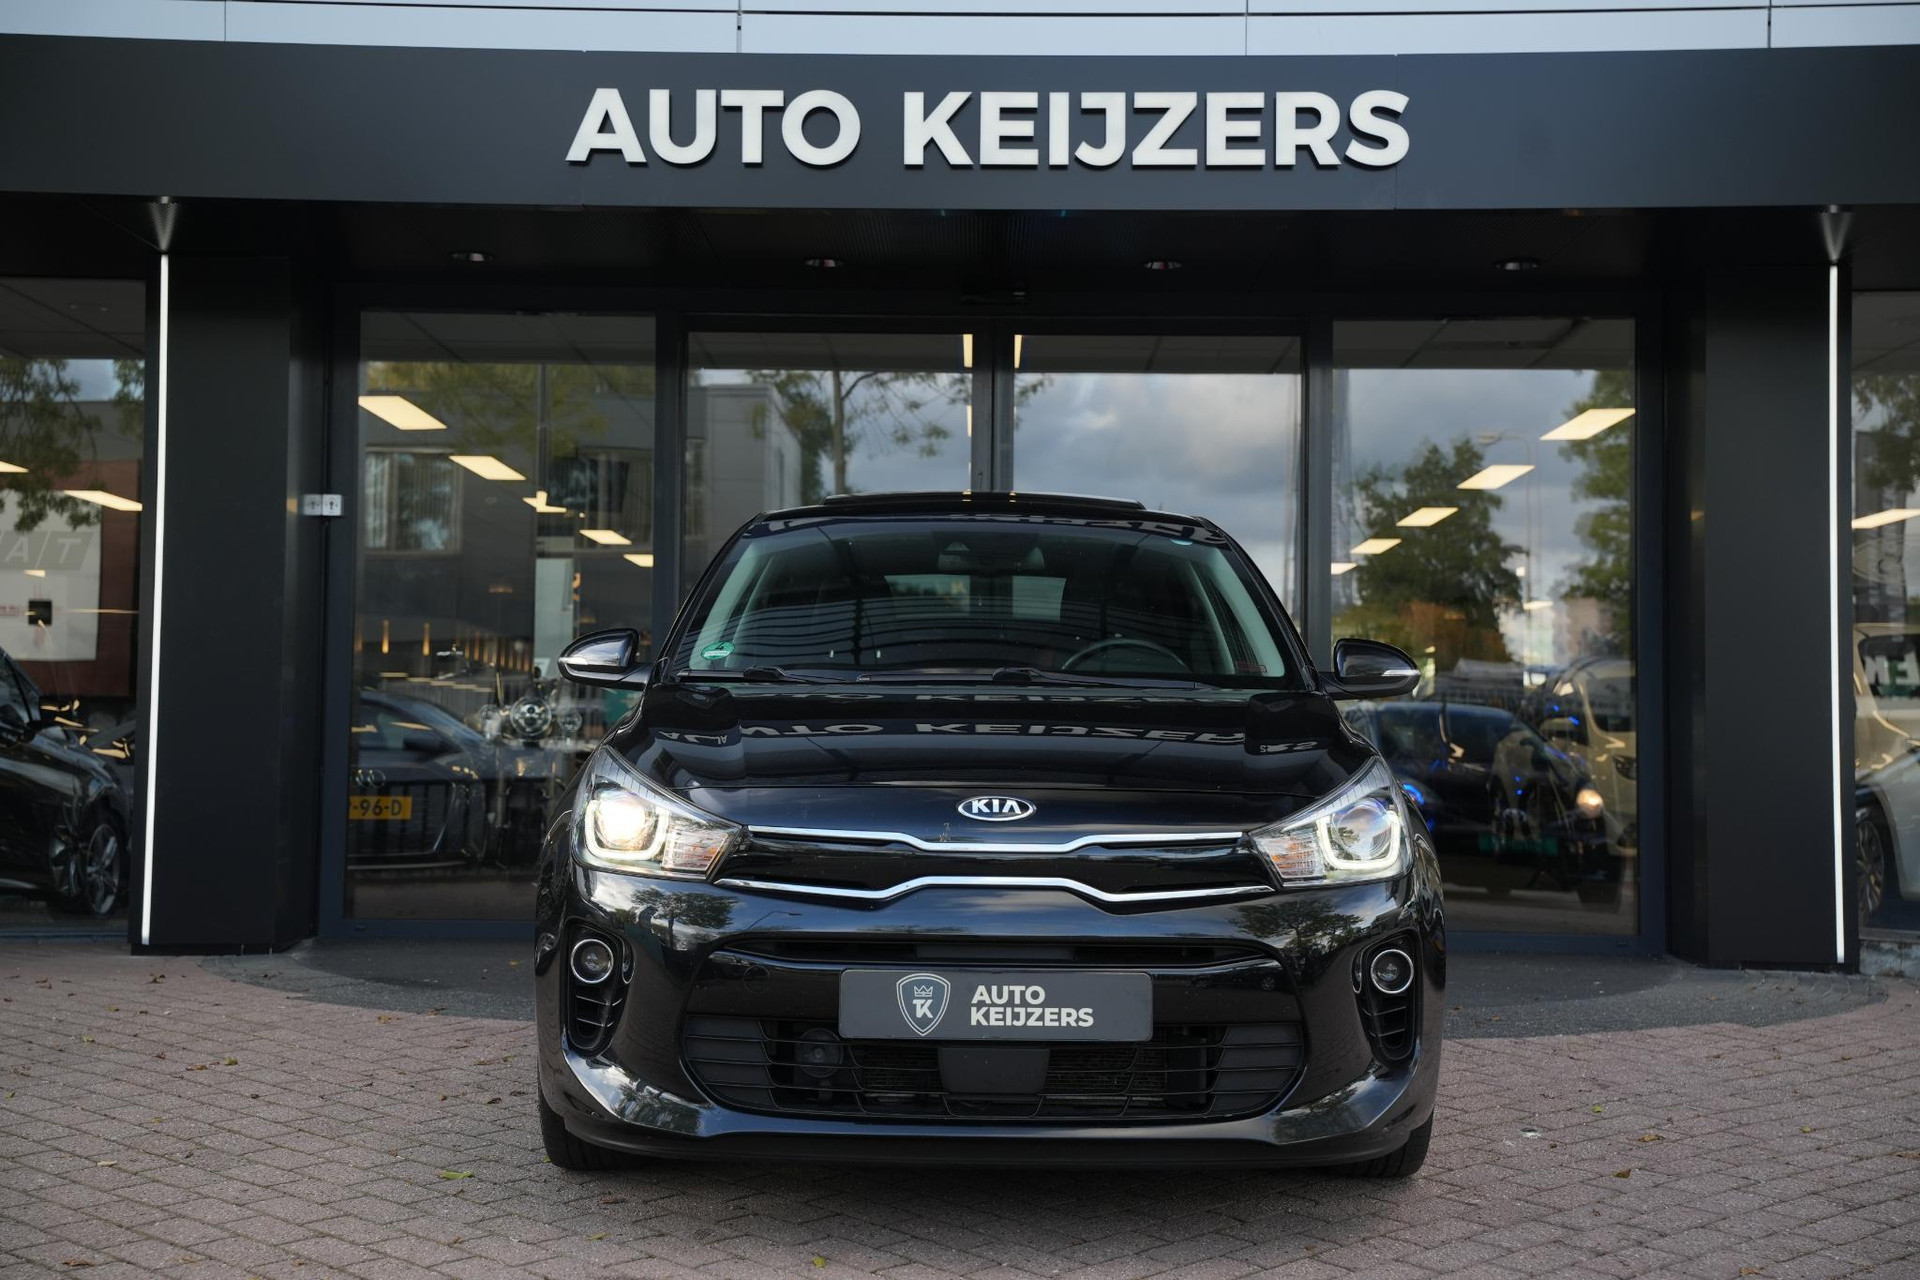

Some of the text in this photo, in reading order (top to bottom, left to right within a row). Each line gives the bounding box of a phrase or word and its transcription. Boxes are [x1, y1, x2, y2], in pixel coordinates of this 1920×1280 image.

[565, 87, 1411, 167] AUTO KEIJZERS
[349, 799, 402, 816] -96-D
[971, 799, 1021, 814] KIA
[971, 985, 1045, 1004] AUTO
[971, 1007, 1094, 1027] KEIJZERS
